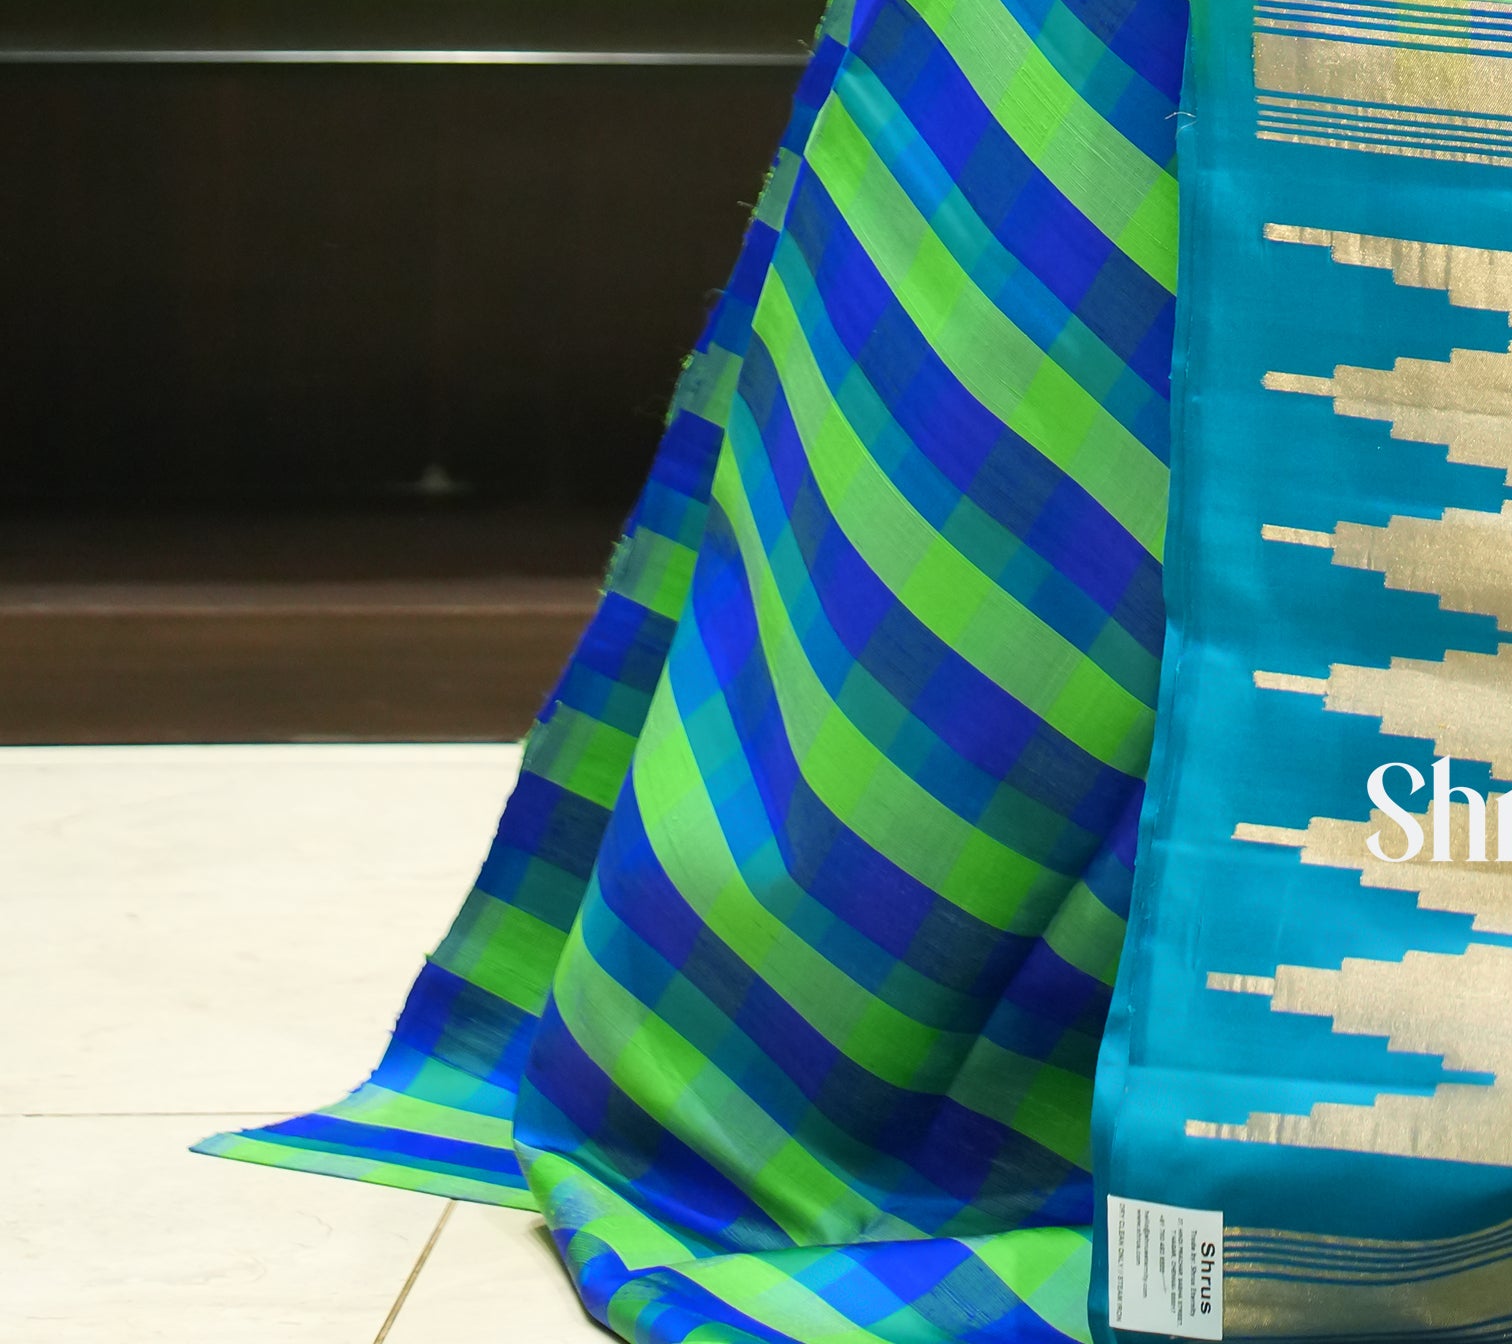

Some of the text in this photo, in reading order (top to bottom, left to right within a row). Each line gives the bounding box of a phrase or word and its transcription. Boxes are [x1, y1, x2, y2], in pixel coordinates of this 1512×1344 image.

[1117, 1248, 1125, 1268] ONLY
[1116, 1276, 1124, 1303] STEAM
[1201, 1243, 1215, 1314] Shrus
